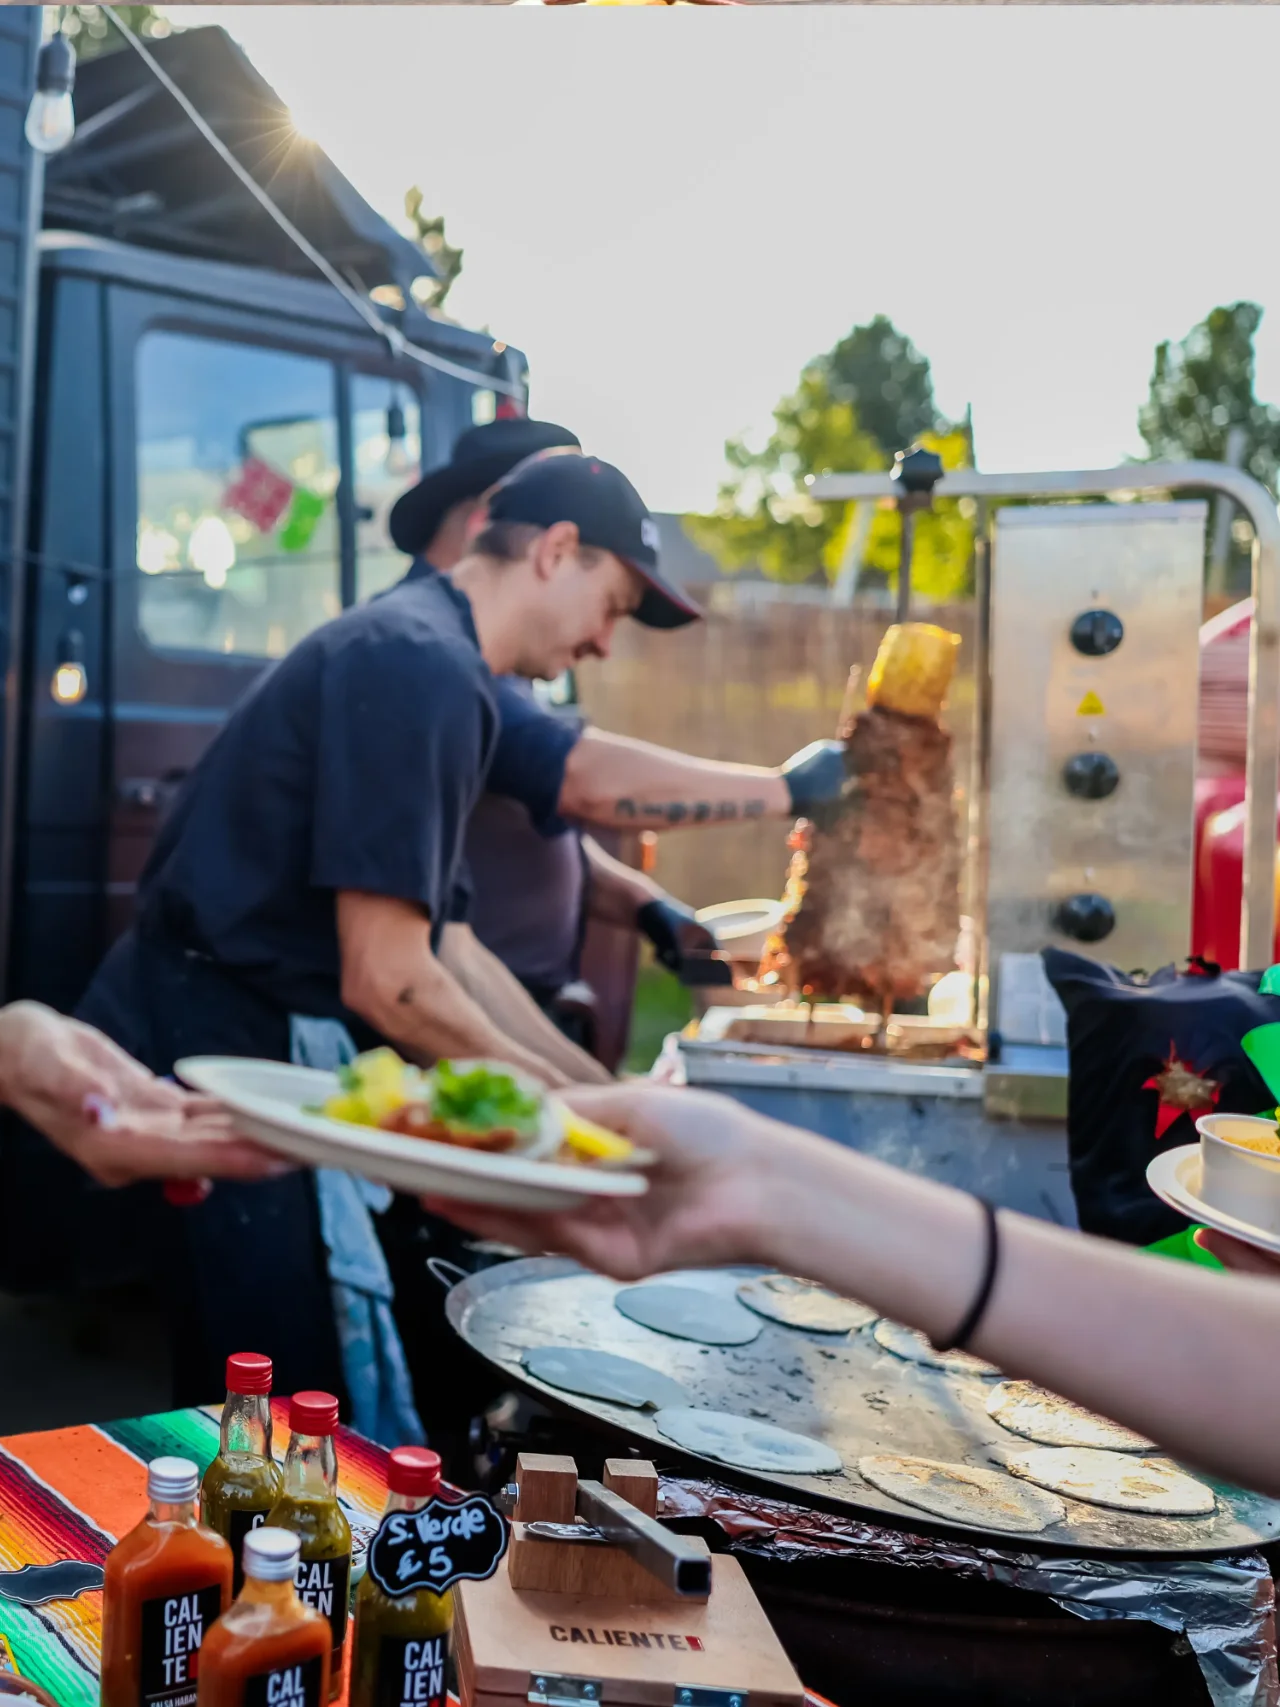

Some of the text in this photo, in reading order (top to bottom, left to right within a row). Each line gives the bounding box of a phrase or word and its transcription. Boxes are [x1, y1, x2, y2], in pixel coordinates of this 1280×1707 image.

[293, 1561, 334, 1589] CAL
[164, 1594, 203, 1627] CAL
[165, 1621, 203, 1656] IEN
[404, 1638, 444, 1670] CAL
[549, 1625, 688, 1651] CALIENTE
[162, 1654, 187, 1686] TE
[267, 1665, 305, 1703] CAL
[404, 1666, 443, 1700] IEN
